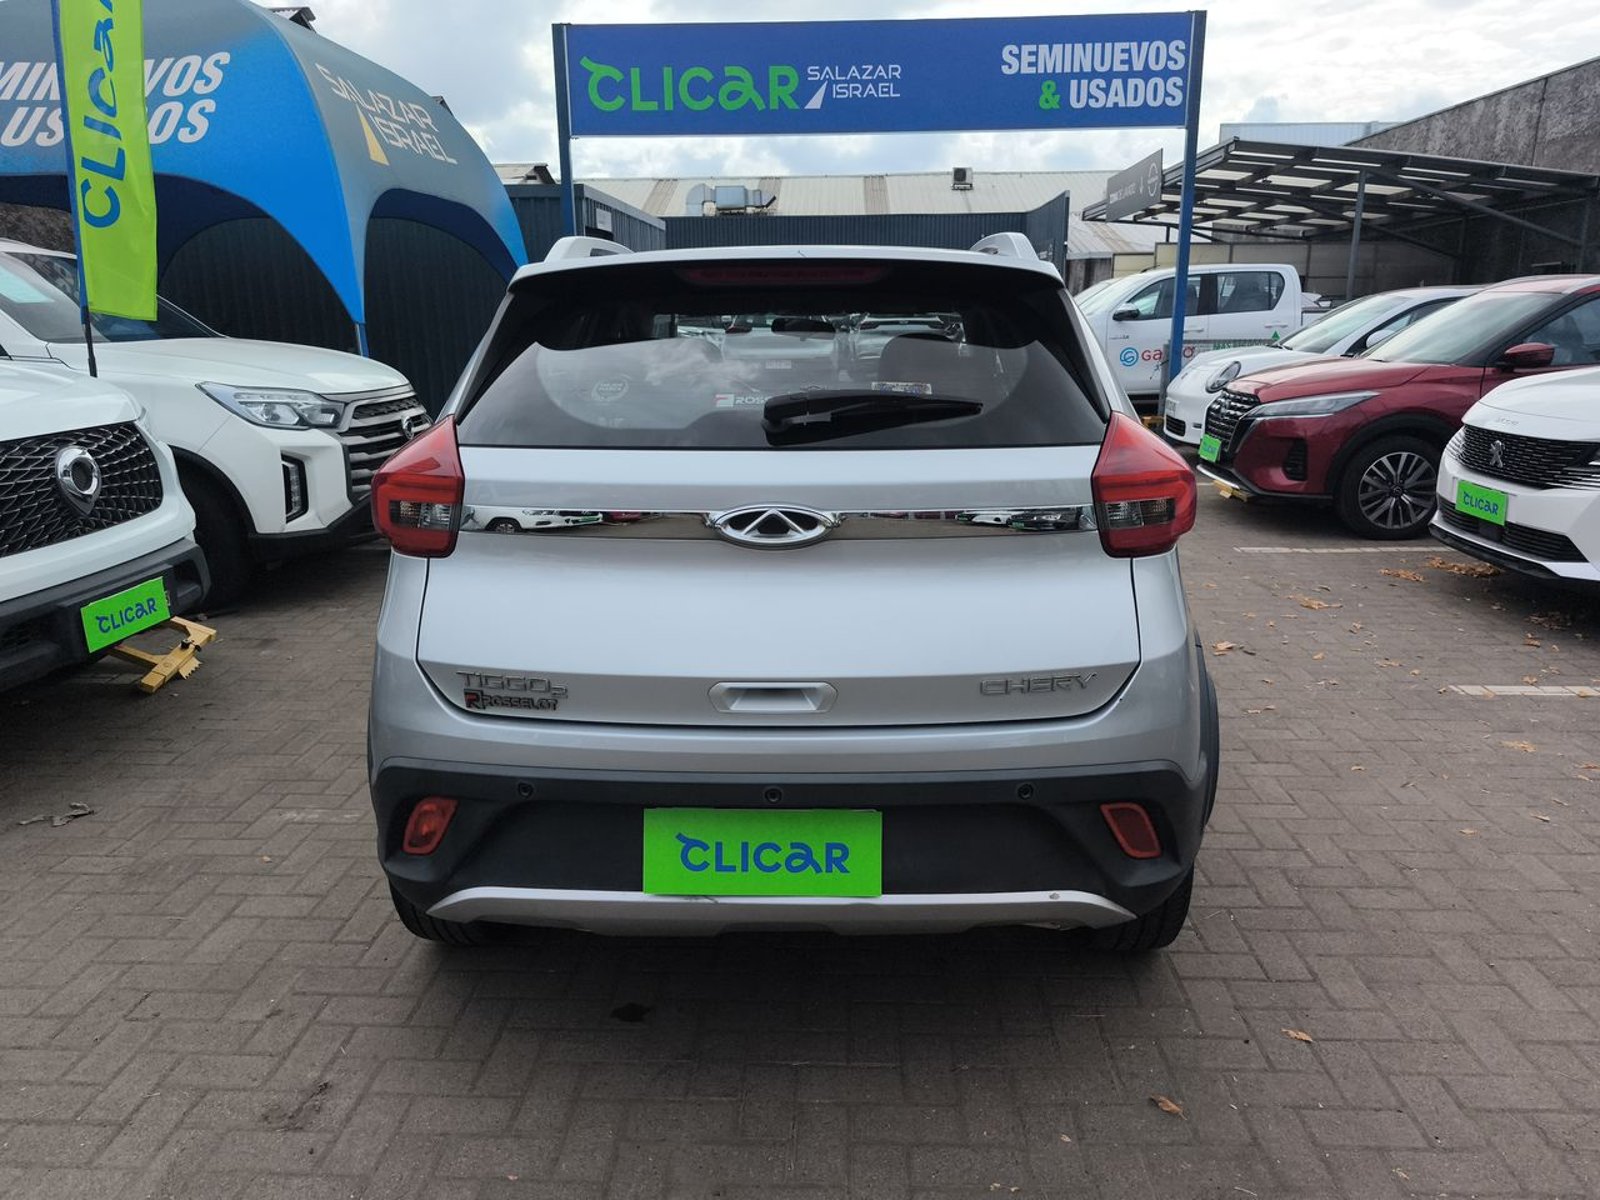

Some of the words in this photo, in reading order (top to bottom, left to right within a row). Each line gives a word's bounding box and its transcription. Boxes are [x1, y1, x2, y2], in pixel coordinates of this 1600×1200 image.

[807, 64, 901, 81] SALAZAR
[1001, 40, 1186, 75] SEMINUEVOS
[314, 62, 439, 132] SALAZAR
[832, 82, 901, 99] ISRAEL
[1038, 80, 1061, 110] &
[1069, 77, 1184, 109] USADOS
[368, 113, 458, 165] ISRAEL
[979, 671, 1097, 696] CHERY
